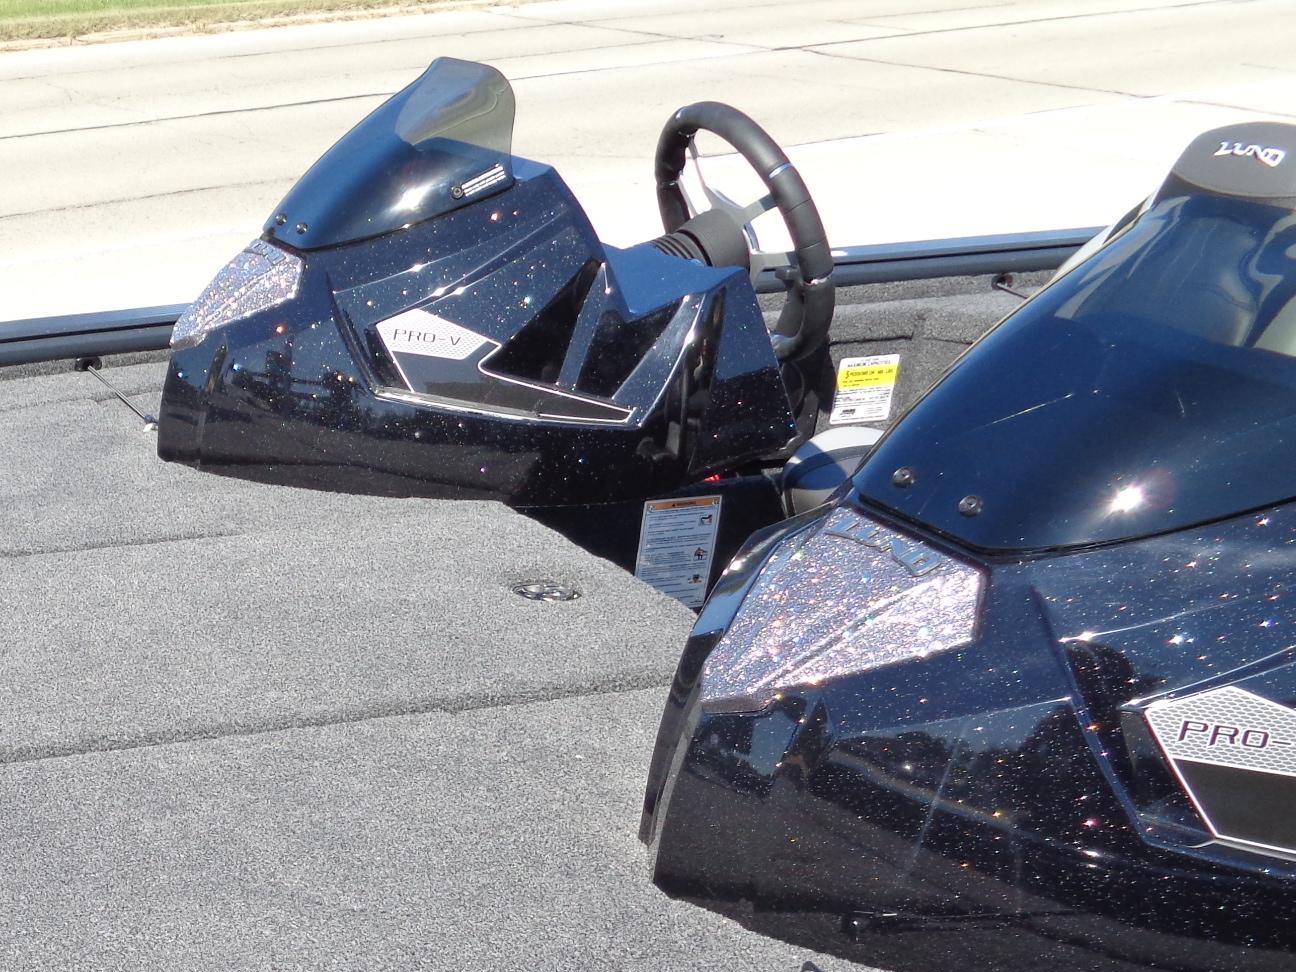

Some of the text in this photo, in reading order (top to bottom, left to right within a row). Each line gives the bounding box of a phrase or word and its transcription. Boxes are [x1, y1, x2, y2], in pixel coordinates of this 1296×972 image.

[393, 328, 462, 346] PRO-V
[824, 516, 943, 577] LUND
[1177, 720, 1294, 750] PRO-
